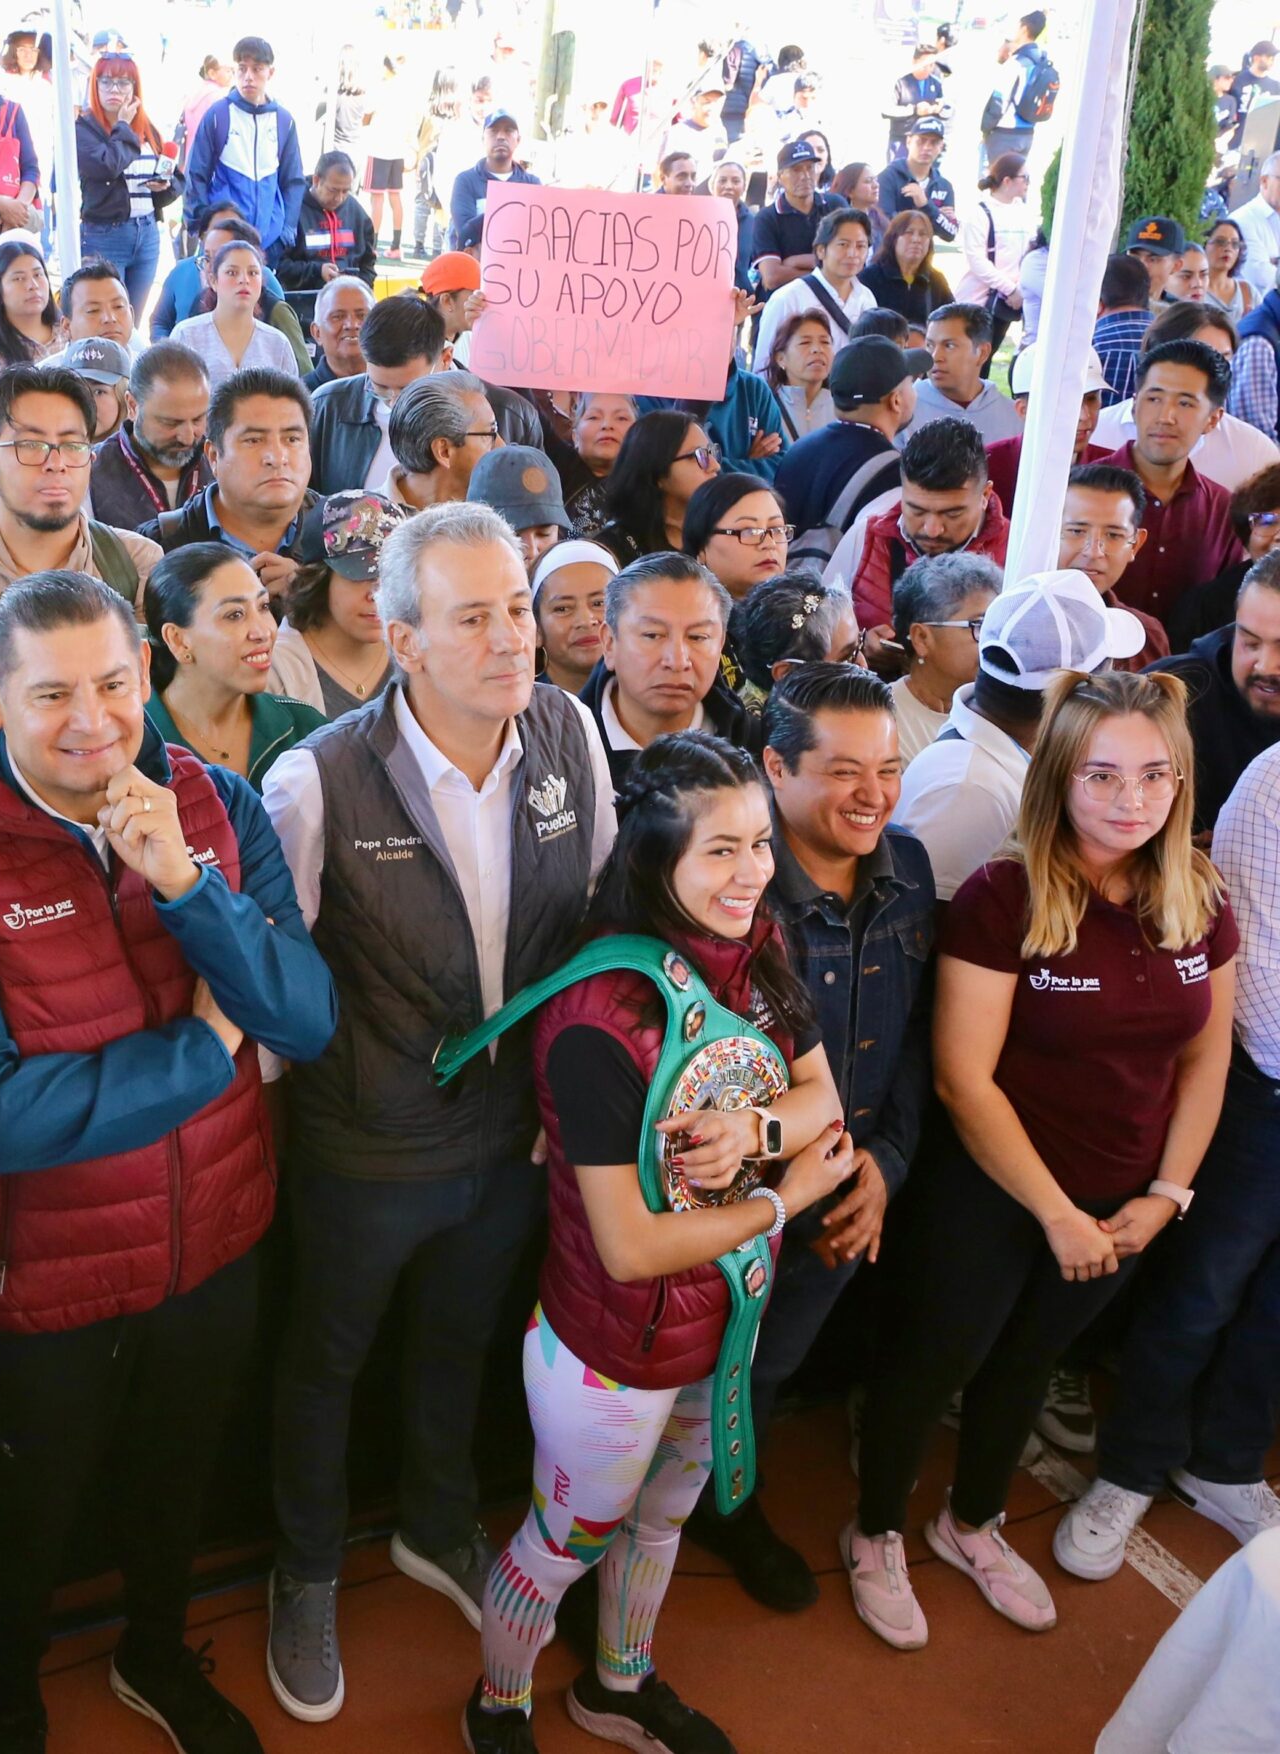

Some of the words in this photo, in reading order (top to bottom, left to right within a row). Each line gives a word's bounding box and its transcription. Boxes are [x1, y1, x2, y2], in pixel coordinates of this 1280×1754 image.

[485, 202, 660, 272] GRACIAS
[674, 218, 733, 279] POR
[482, 263, 540, 308] SU
[555, 273, 682, 325] APOYO
[474, 311, 706, 388] GOBERNADOR
[535, 810, 576, 837] Puebla
[355, 840, 381, 851] Pepe
[376, 849, 414, 861] Alcalde
[25, 908, 44, 919] Por
[43, 905, 55, 914] la
[55, 900, 74, 913] paz
[1051, 976, 1070, 985] Por
[1071, 976, 1081, 986] la
[1083, 978, 1100, 987] paz
